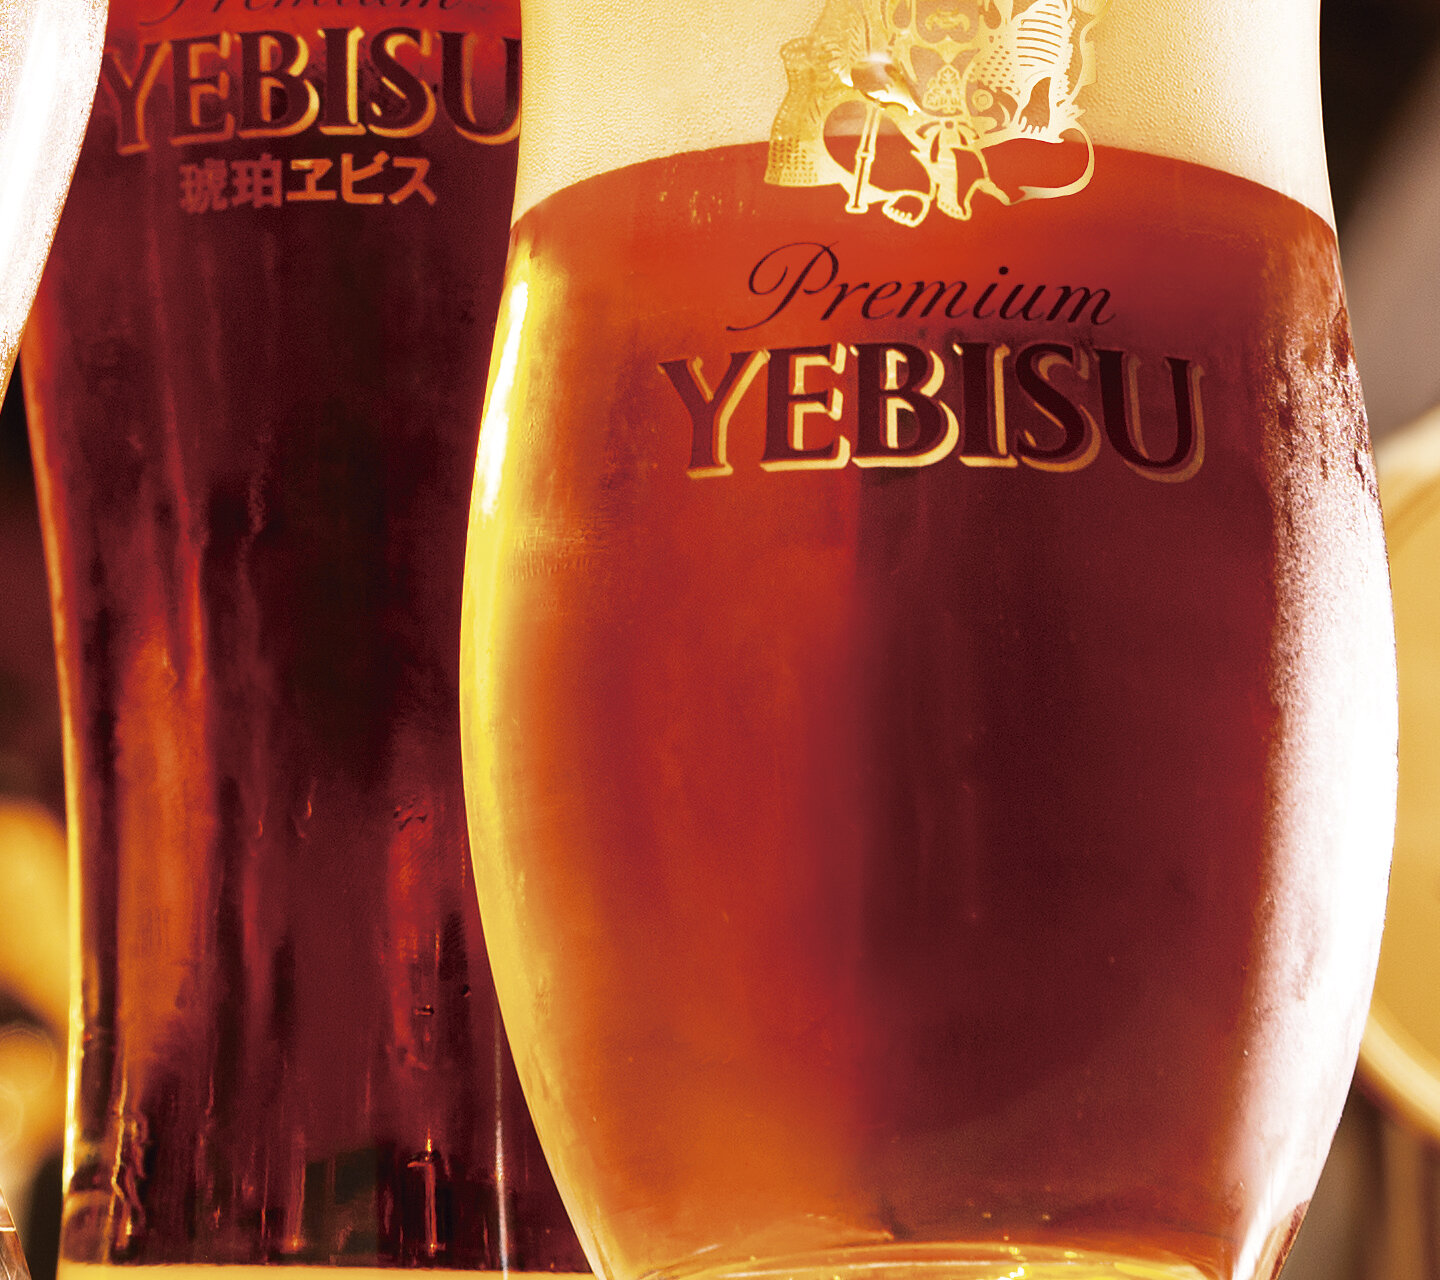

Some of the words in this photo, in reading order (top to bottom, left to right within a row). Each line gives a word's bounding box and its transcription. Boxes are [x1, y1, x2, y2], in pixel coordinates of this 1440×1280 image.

[99, 26, 522, 156] YEBISU
[725, 241, 1116, 332] Premium
[657, 342, 1206, 484] YEBISU
